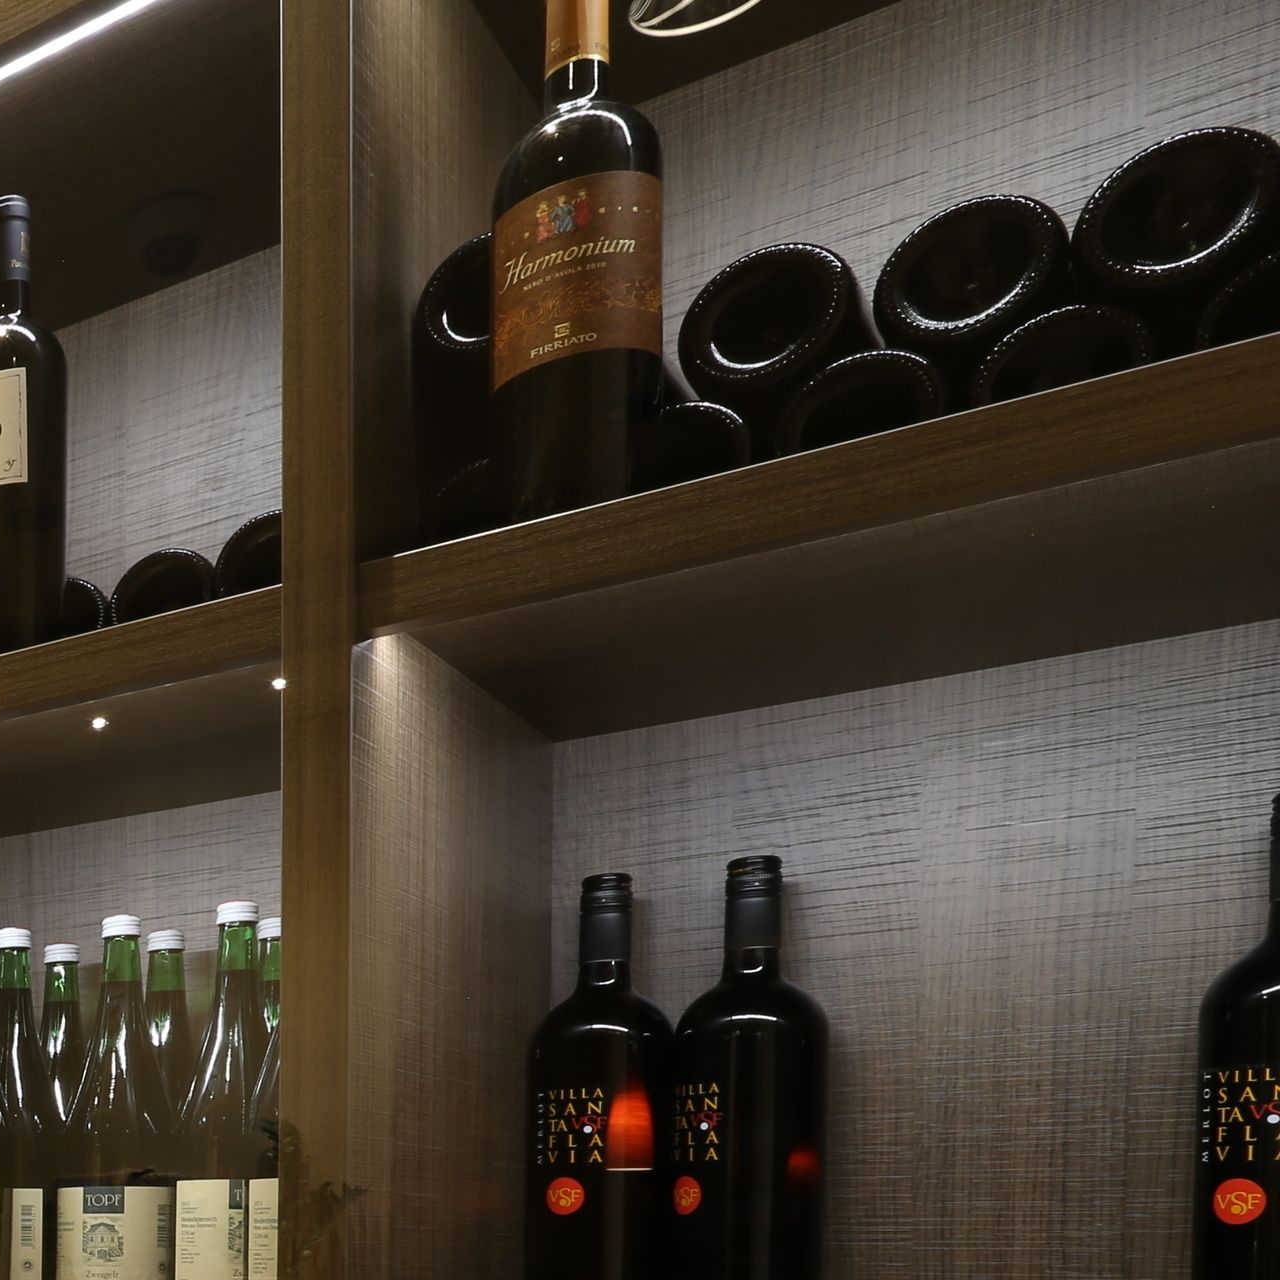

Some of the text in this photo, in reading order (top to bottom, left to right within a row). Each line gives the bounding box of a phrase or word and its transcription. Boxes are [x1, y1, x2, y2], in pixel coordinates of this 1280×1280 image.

[499, 237, 636, 295] Harmonium
[522, 261, 607, 292] NERO D'AVOLA 2010
[530, 332, 598, 359] FIRRIATO
[549, 1087, 604, 1100] VILLA
[549, 1101, 602, 1117] SAN
[1217, 1106, 1244, 1123] TA
[549, 1119, 568, 1132] TA
[1201, 1072, 1212, 1163] MERLOT
[549, 1134, 604, 1148] FLA
[548, 1150, 603, 1163] VIA
[85, 1193, 123, 1207] TOPF
[549, 1187, 581, 1207] VSF
[1216, 1191, 1262, 1216] VSF
[85, 1270, 119, 1280] Zweigelt
